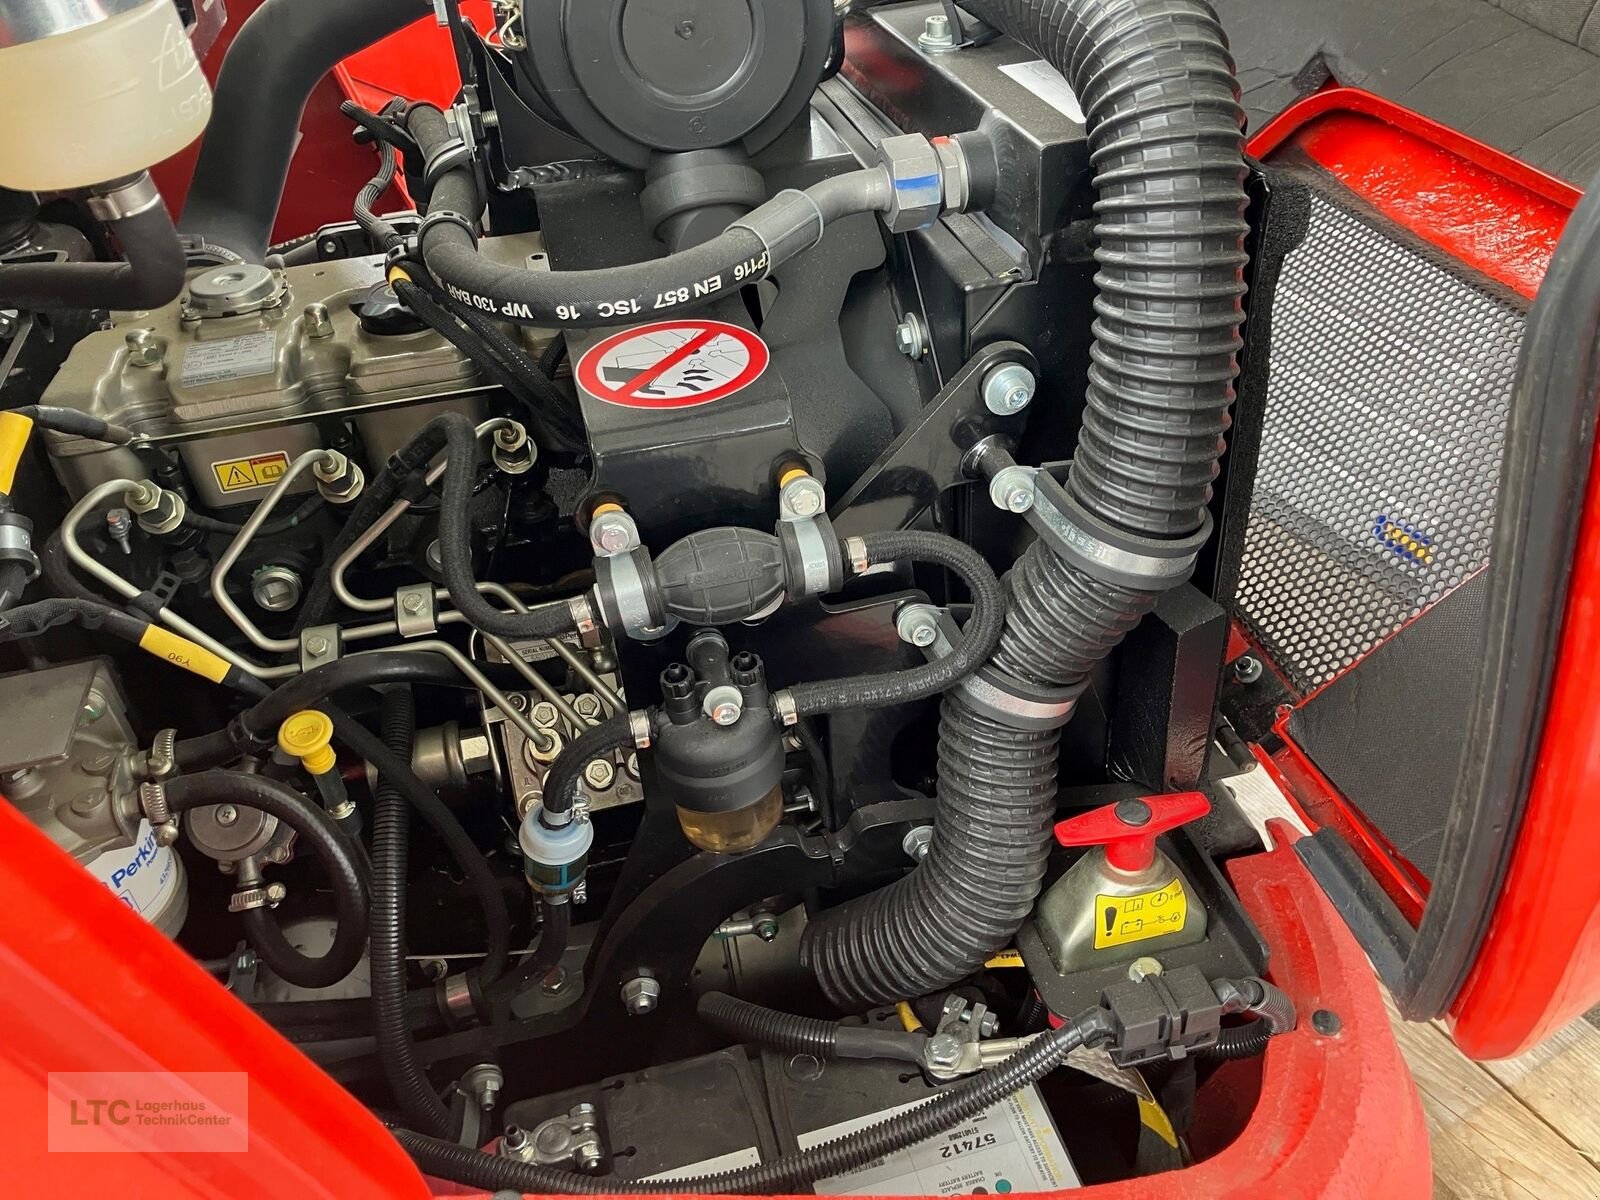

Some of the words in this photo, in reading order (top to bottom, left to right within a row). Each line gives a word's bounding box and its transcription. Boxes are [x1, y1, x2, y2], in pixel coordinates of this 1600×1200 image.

[734, 249, 769, 281] P116
[447, 283, 472, 306] BAR
[694, 275, 722, 298] EN
[472, 293, 498, 313] 130
[597, 298, 641, 318] 1SC
[653, 287, 690, 309] 857
[501, 302, 533, 319] WP
[555, 304, 580, 320] 16
[168, 652, 190, 667] Y90
[111, 831, 155, 888] Perkin
[939, 1133, 996, 1158] 57412
[939, 1177, 960, 1188] BATTERY
[962, 1170, 983, 1181] BATTERY
[965, 1176, 986, 1187] CHARGE
[941, 1183, 963, 1194] REPLACE
